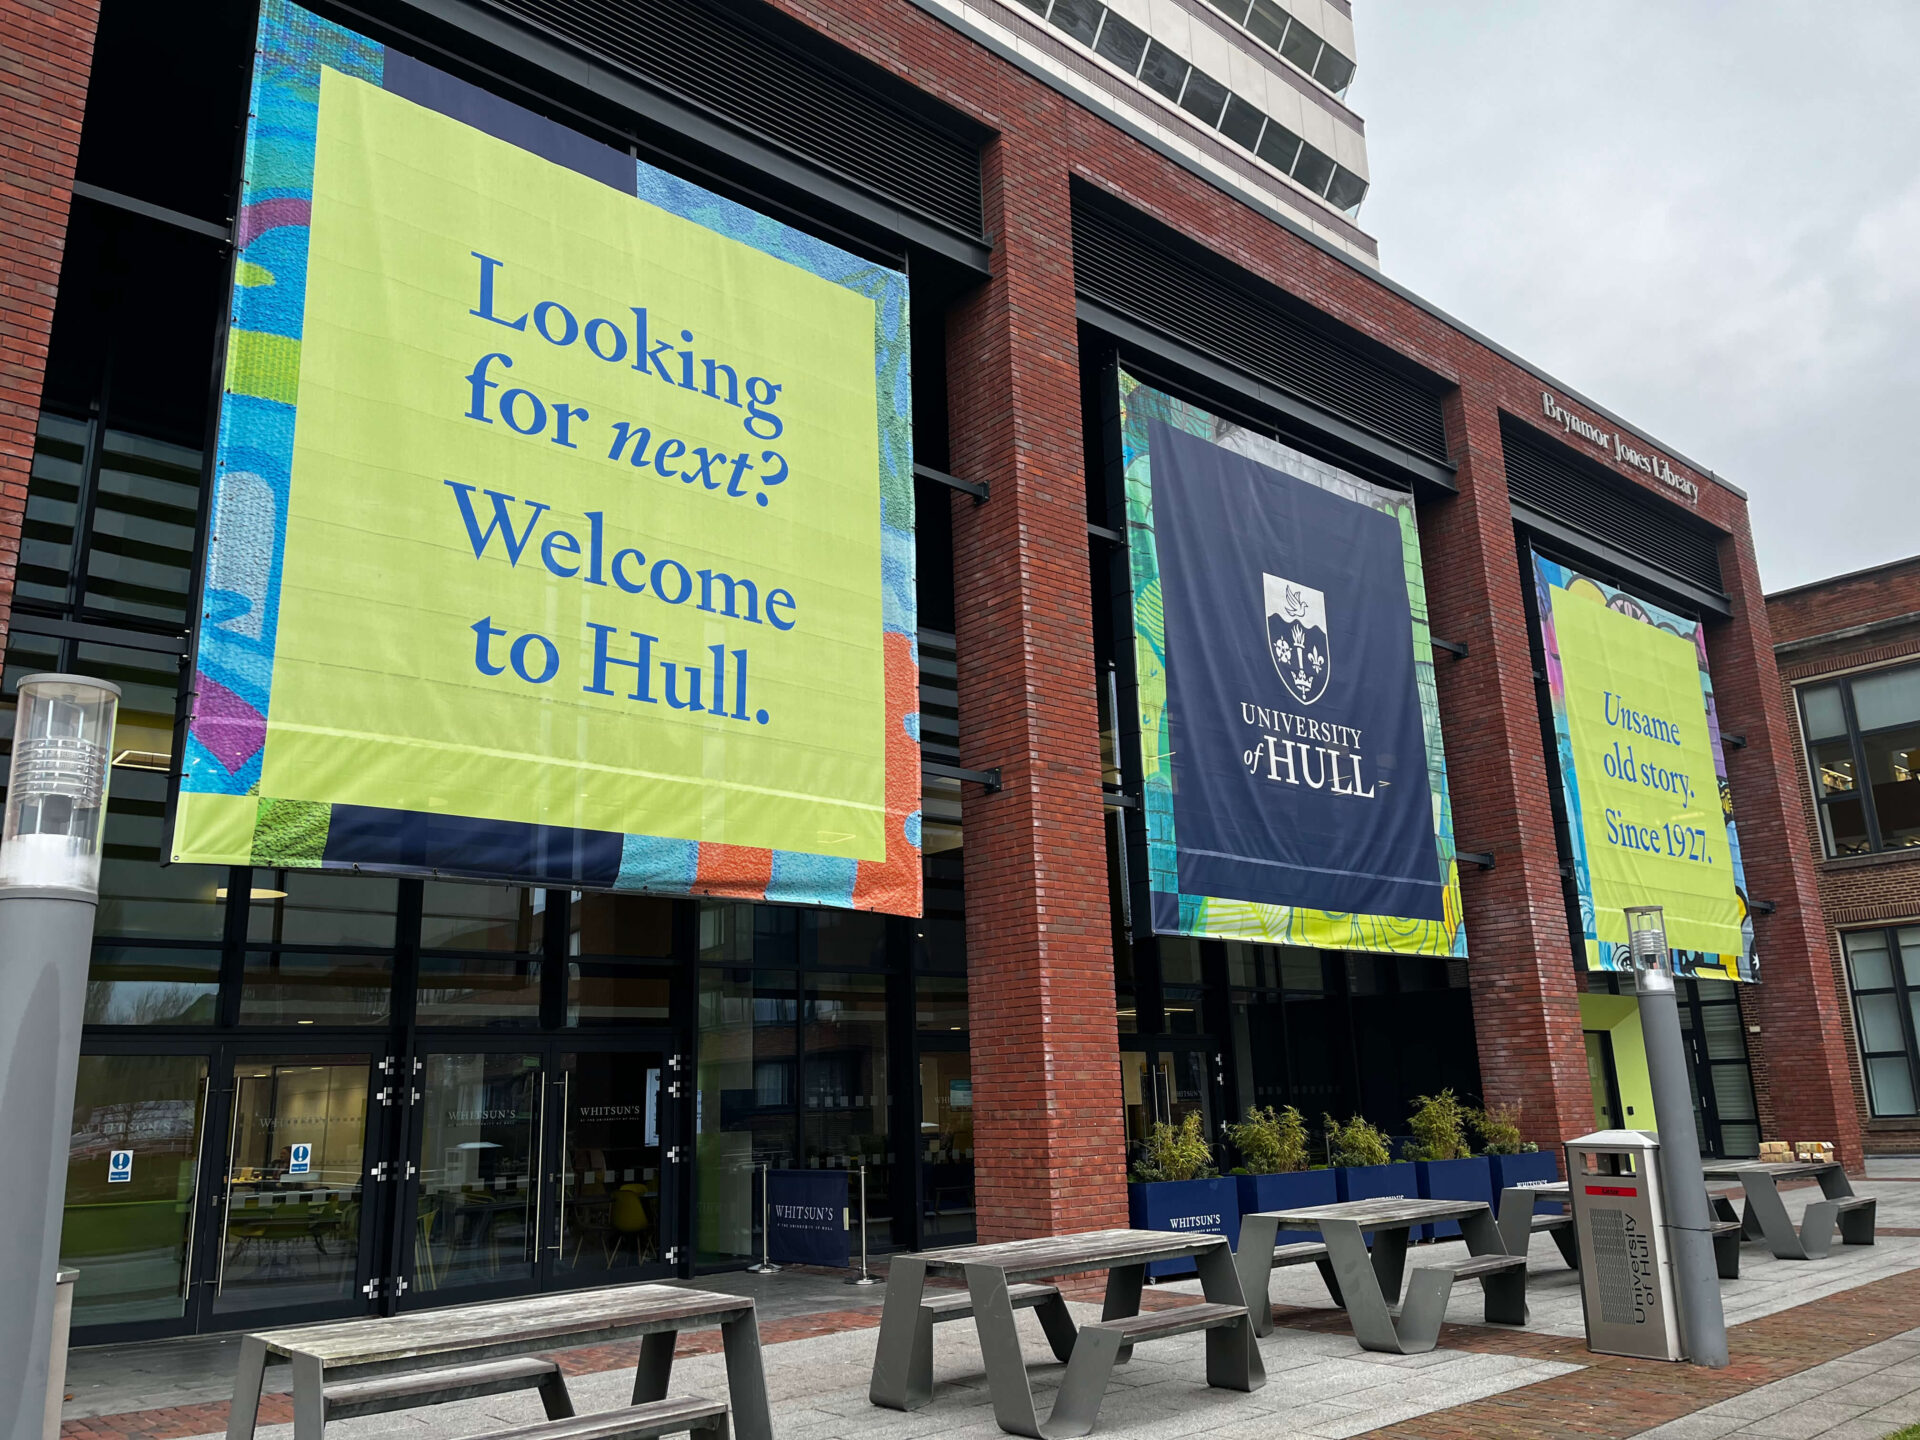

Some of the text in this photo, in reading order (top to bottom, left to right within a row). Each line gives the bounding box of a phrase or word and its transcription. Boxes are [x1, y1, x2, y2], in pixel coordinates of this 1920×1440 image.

[469, 251, 783, 440] Looking
[465, 353, 789, 507] for next?
[1541, 391, 1698, 505] Brynmor Jones Library
[444, 480, 796, 631] Welcome
[470, 616, 769, 725] to Hull.
[1240, 702, 1362, 749] UNIVERSITY
[1603, 691, 1681, 746] Unsame
[1243, 735, 1375, 798] of HULL
[1603, 741, 1695, 808] old story.
[1605, 808, 1712, 864] Since 1927.
[448, 1109, 516, 1121] WHITSUN'S
[580, 1106, 640, 1116] WHITSUN'S
[775, 1204, 834, 1221] WHITSUN'S
[1169, 1214, 1221, 1229] WHITSUN'S
[1625, 1213, 1646, 1324] University
[1636, 1234, 1655, 1306] of Hull
